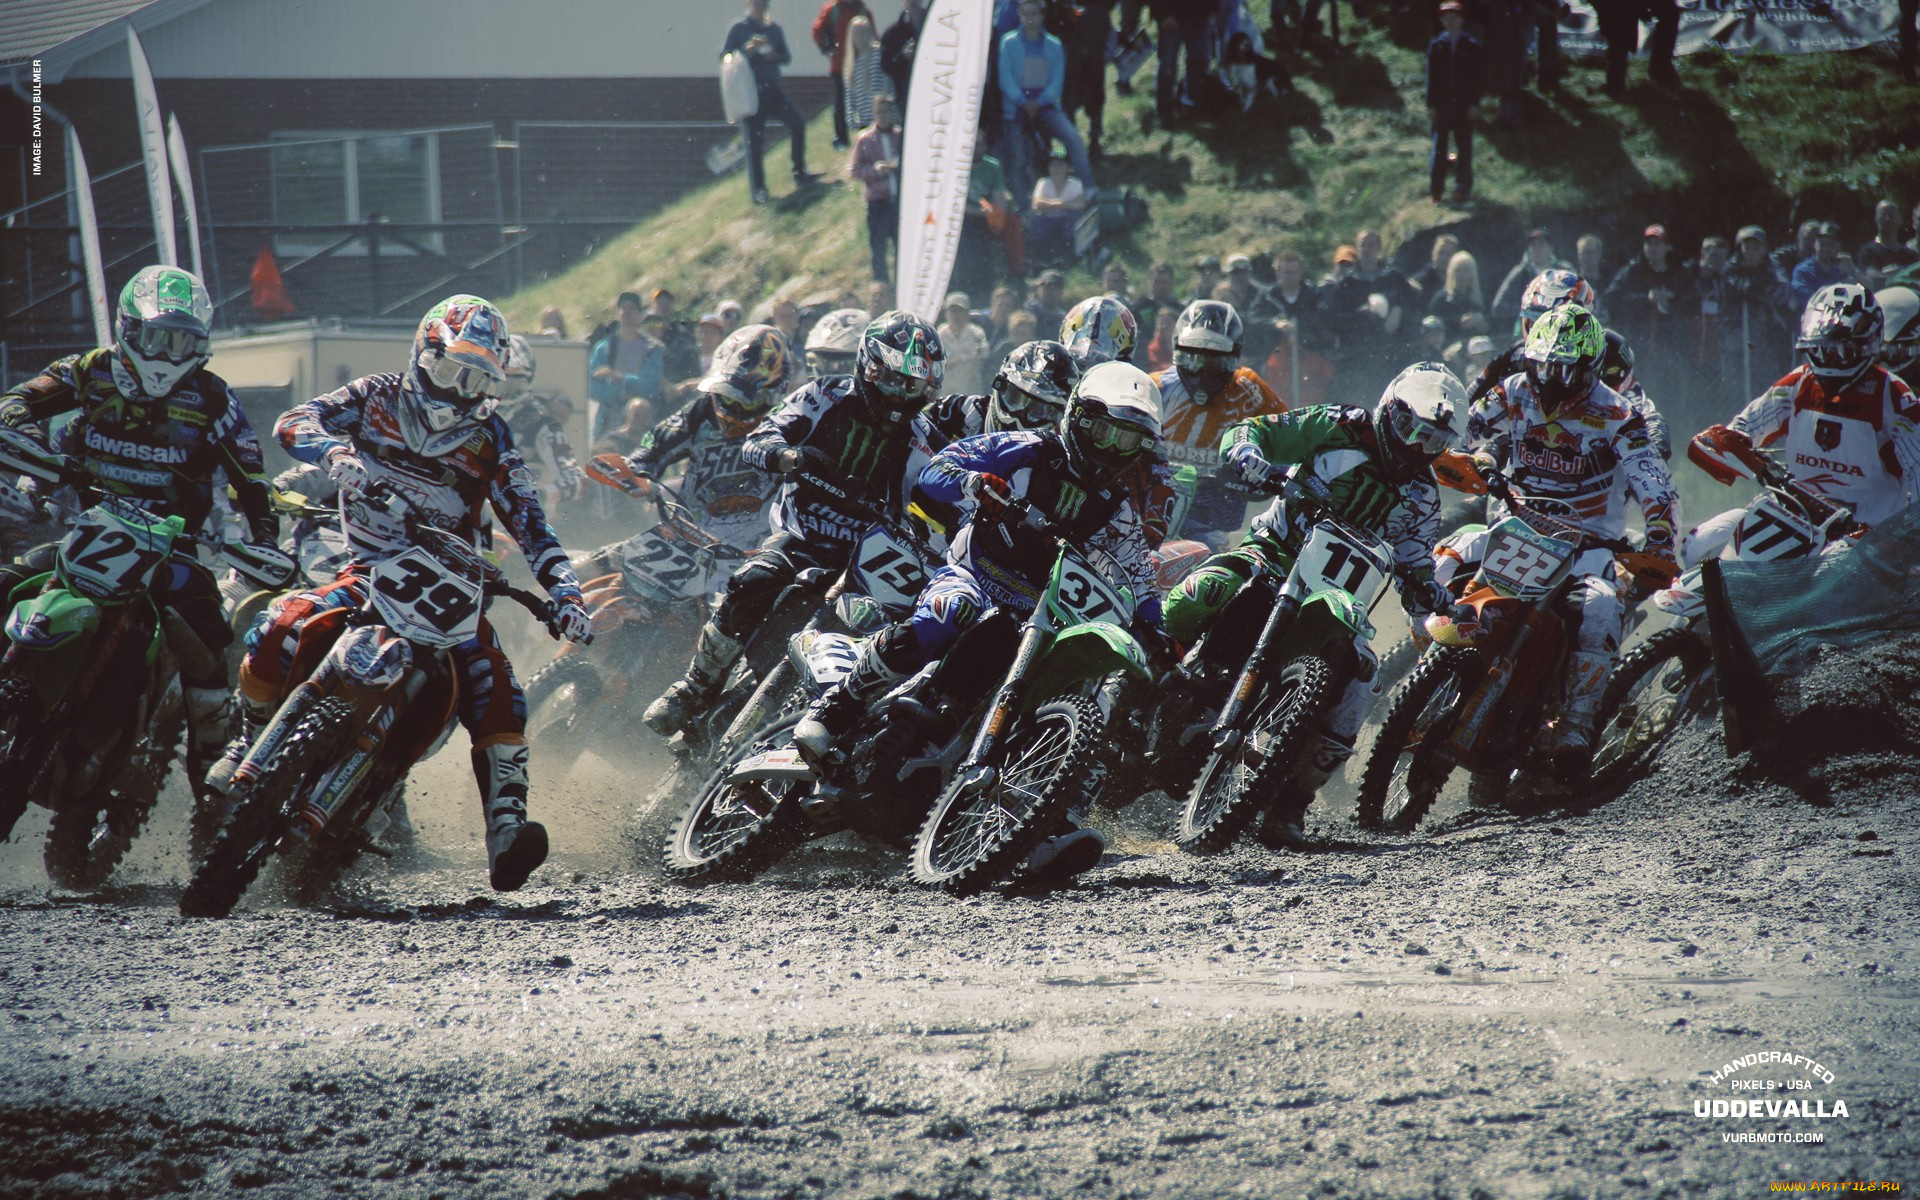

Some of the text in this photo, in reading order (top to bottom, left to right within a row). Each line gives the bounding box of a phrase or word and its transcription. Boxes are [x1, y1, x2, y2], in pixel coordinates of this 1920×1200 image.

[926, 9, 962, 201] UDDEVALLA
[100, 465, 169, 485] MOTOREX
[1517, 443, 1586, 476] Red Bull
[1795, 453, 1866, 477] HONDA
[66, 525, 166, 592] 121
[627, 539, 700, 592] 22
[1321, 541, 1371, 596] 11
[1483, 535, 1562, 588] 222
[373, 558, 479, 633] 39
[1059, 571, 1115, 620] 37
[331, 749, 366, 794] MOTOREX
